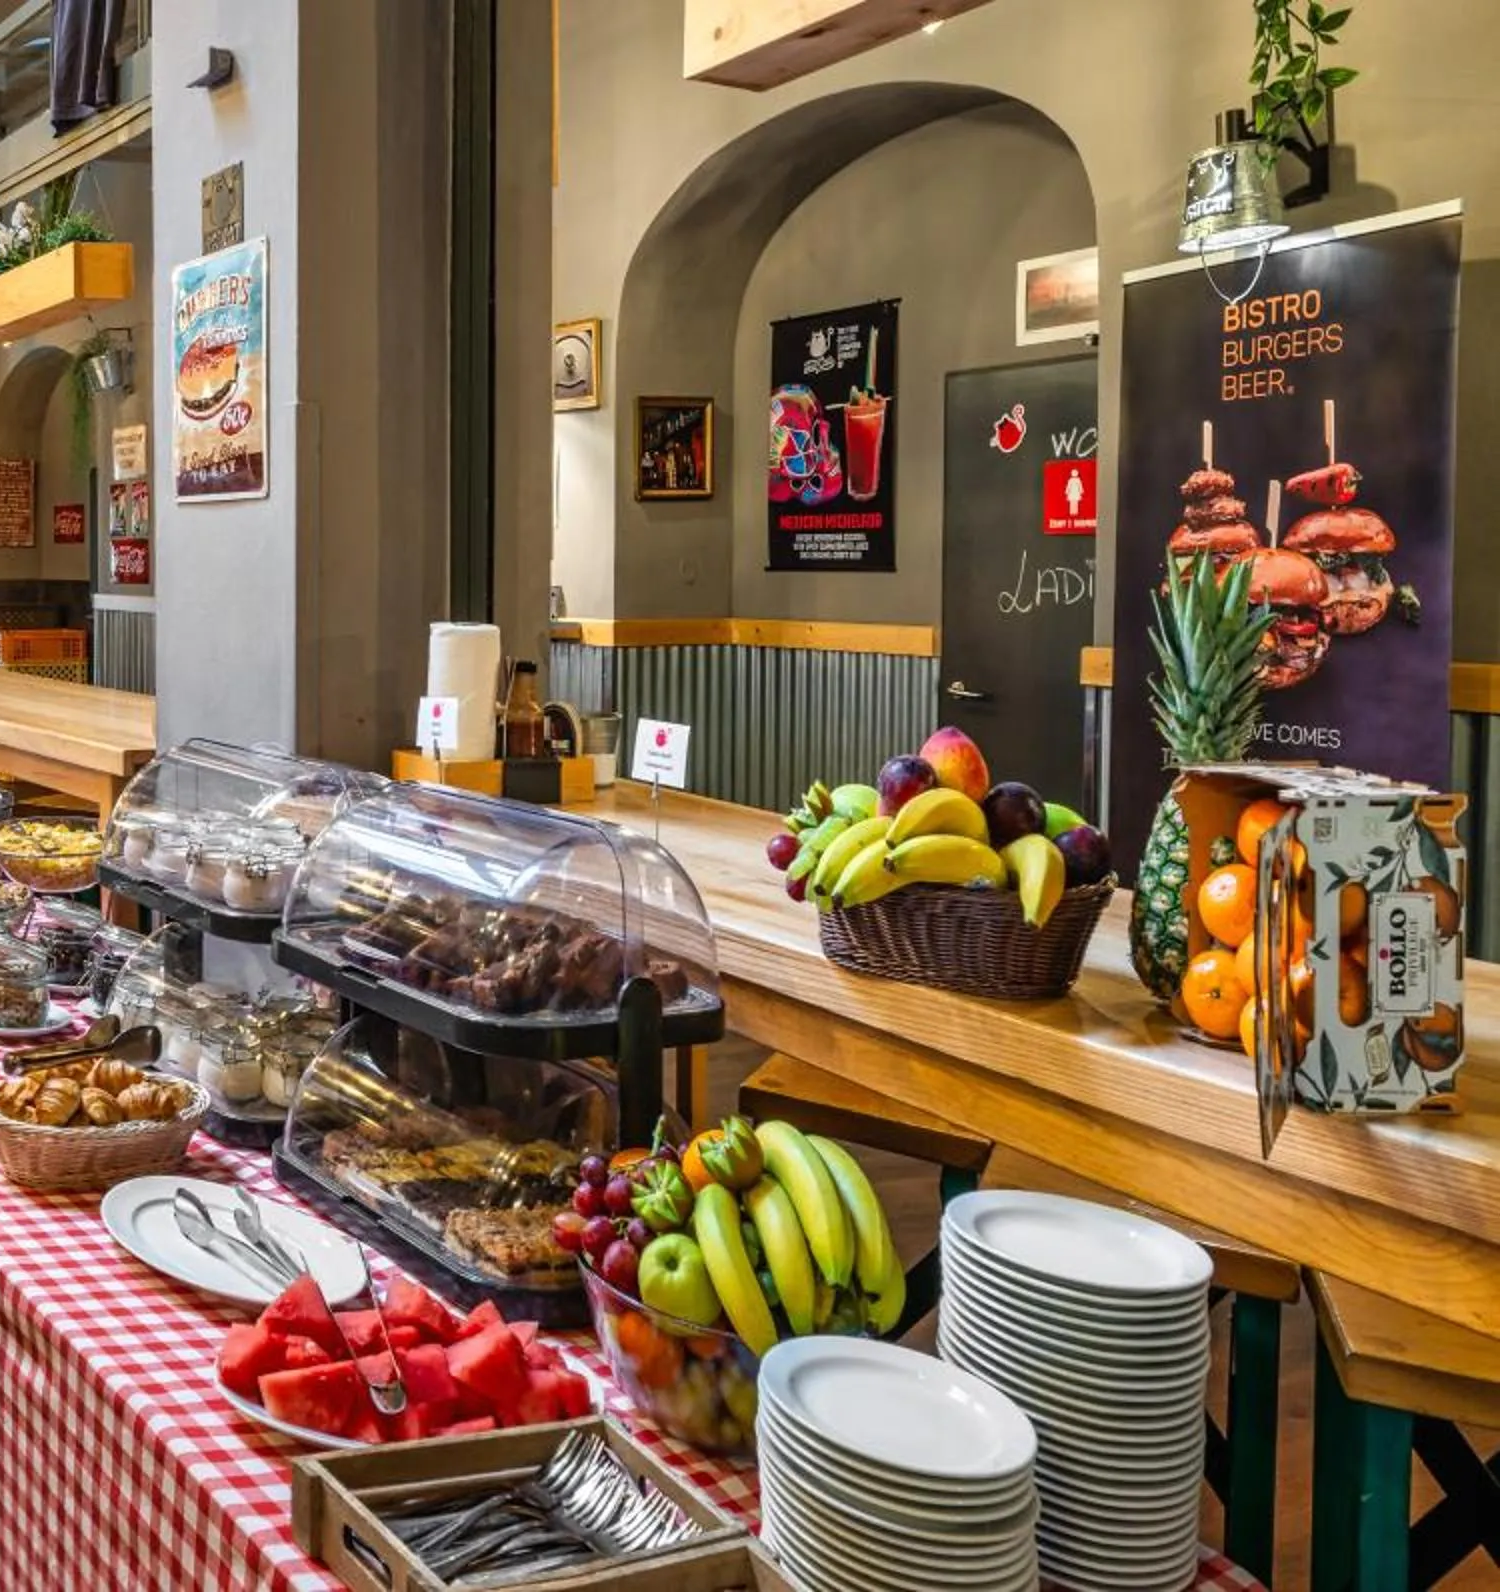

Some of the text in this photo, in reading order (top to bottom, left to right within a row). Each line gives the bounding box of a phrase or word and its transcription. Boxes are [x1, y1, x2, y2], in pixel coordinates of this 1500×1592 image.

[1223, 289, 1322, 333] BISTRO
[1222, 323, 1344, 368] BURGERS
[1052, 427, 1099, 457] WC
[1277, 723, 1341, 749] COMES
[1388, 908, 1407, 998] BOLLO
